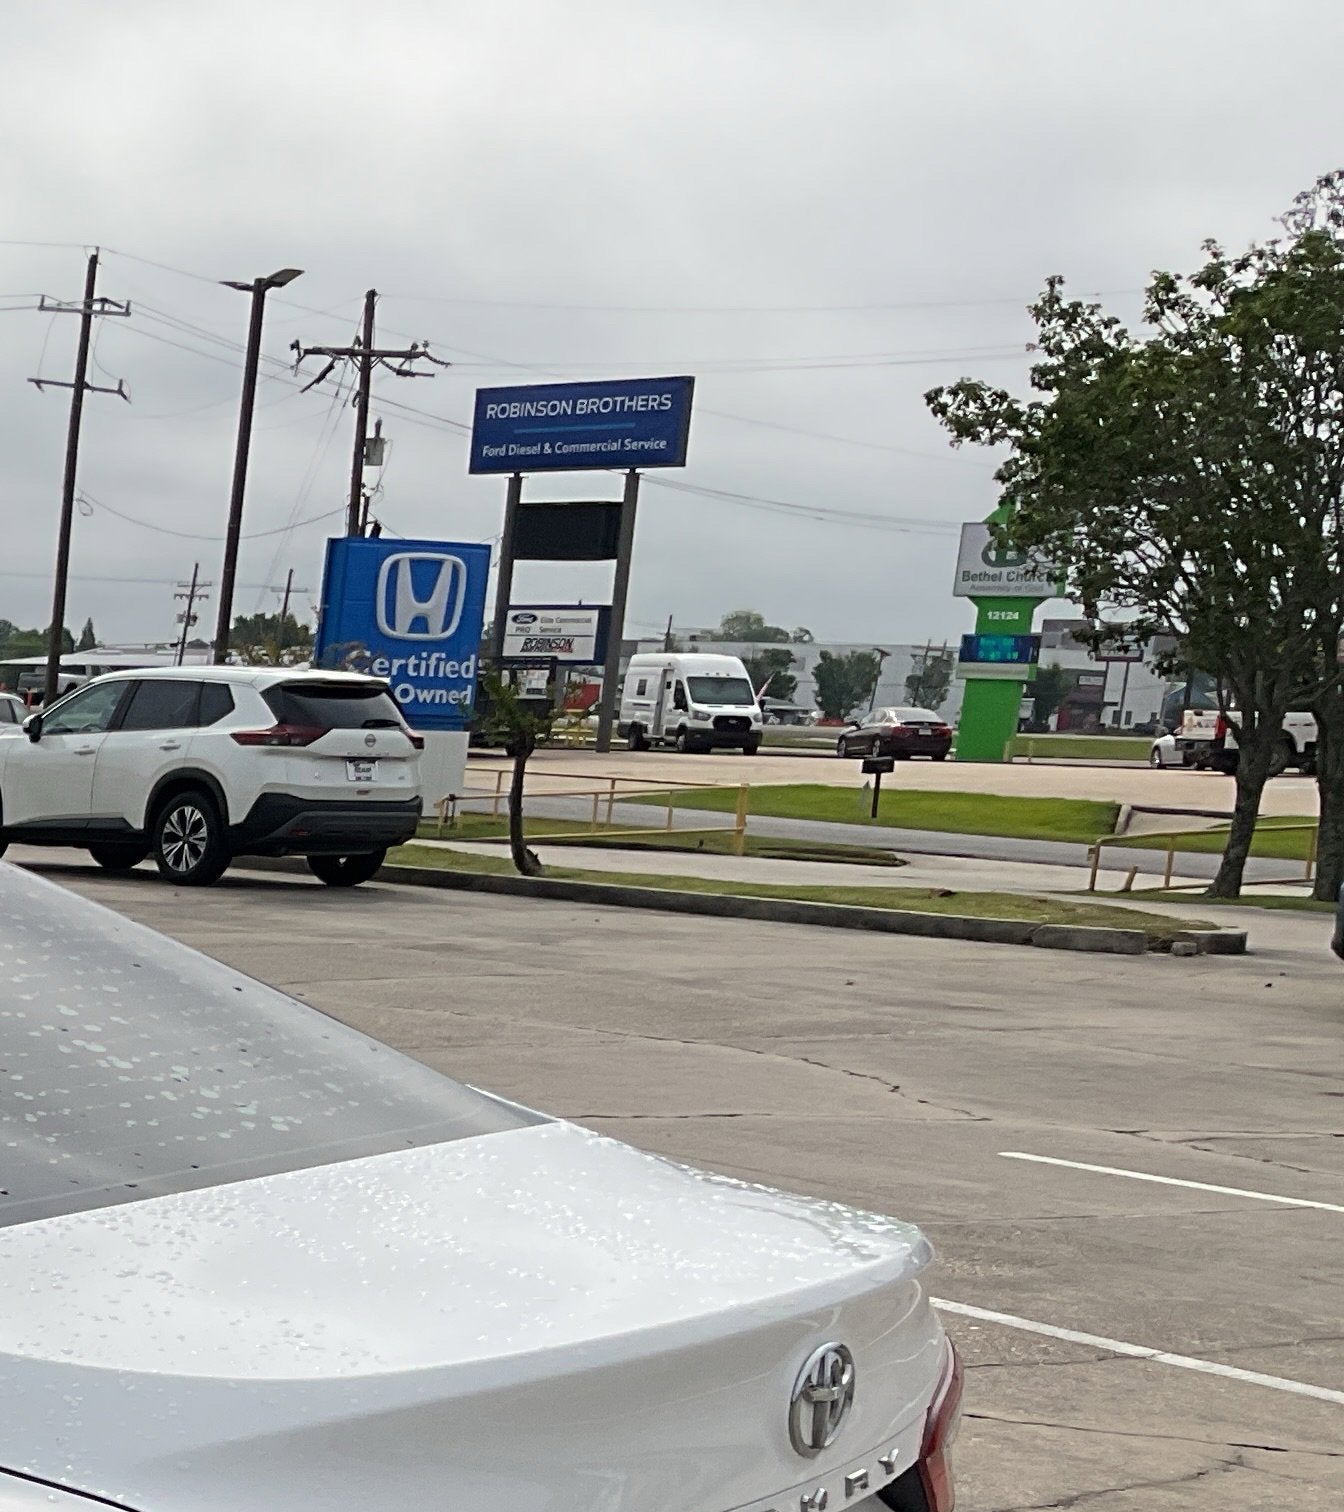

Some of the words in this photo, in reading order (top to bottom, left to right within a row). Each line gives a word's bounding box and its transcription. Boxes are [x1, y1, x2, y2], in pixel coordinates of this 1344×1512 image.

[486, 400, 573, 419] ROBINSON
[575, 394, 672, 415] BROTHERS
[482, 443, 506, 457] Ford
[508, 442, 541, 456] Diesel
[543, 442, 552, 454] &
[555, 439, 622, 454] Commercial
[624, 437, 667, 450] Service
[961, 570, 1002, 582] Bethel
[1007, 569, 1055, 583] Churc
[987, 611, 1019, 620] 12124
